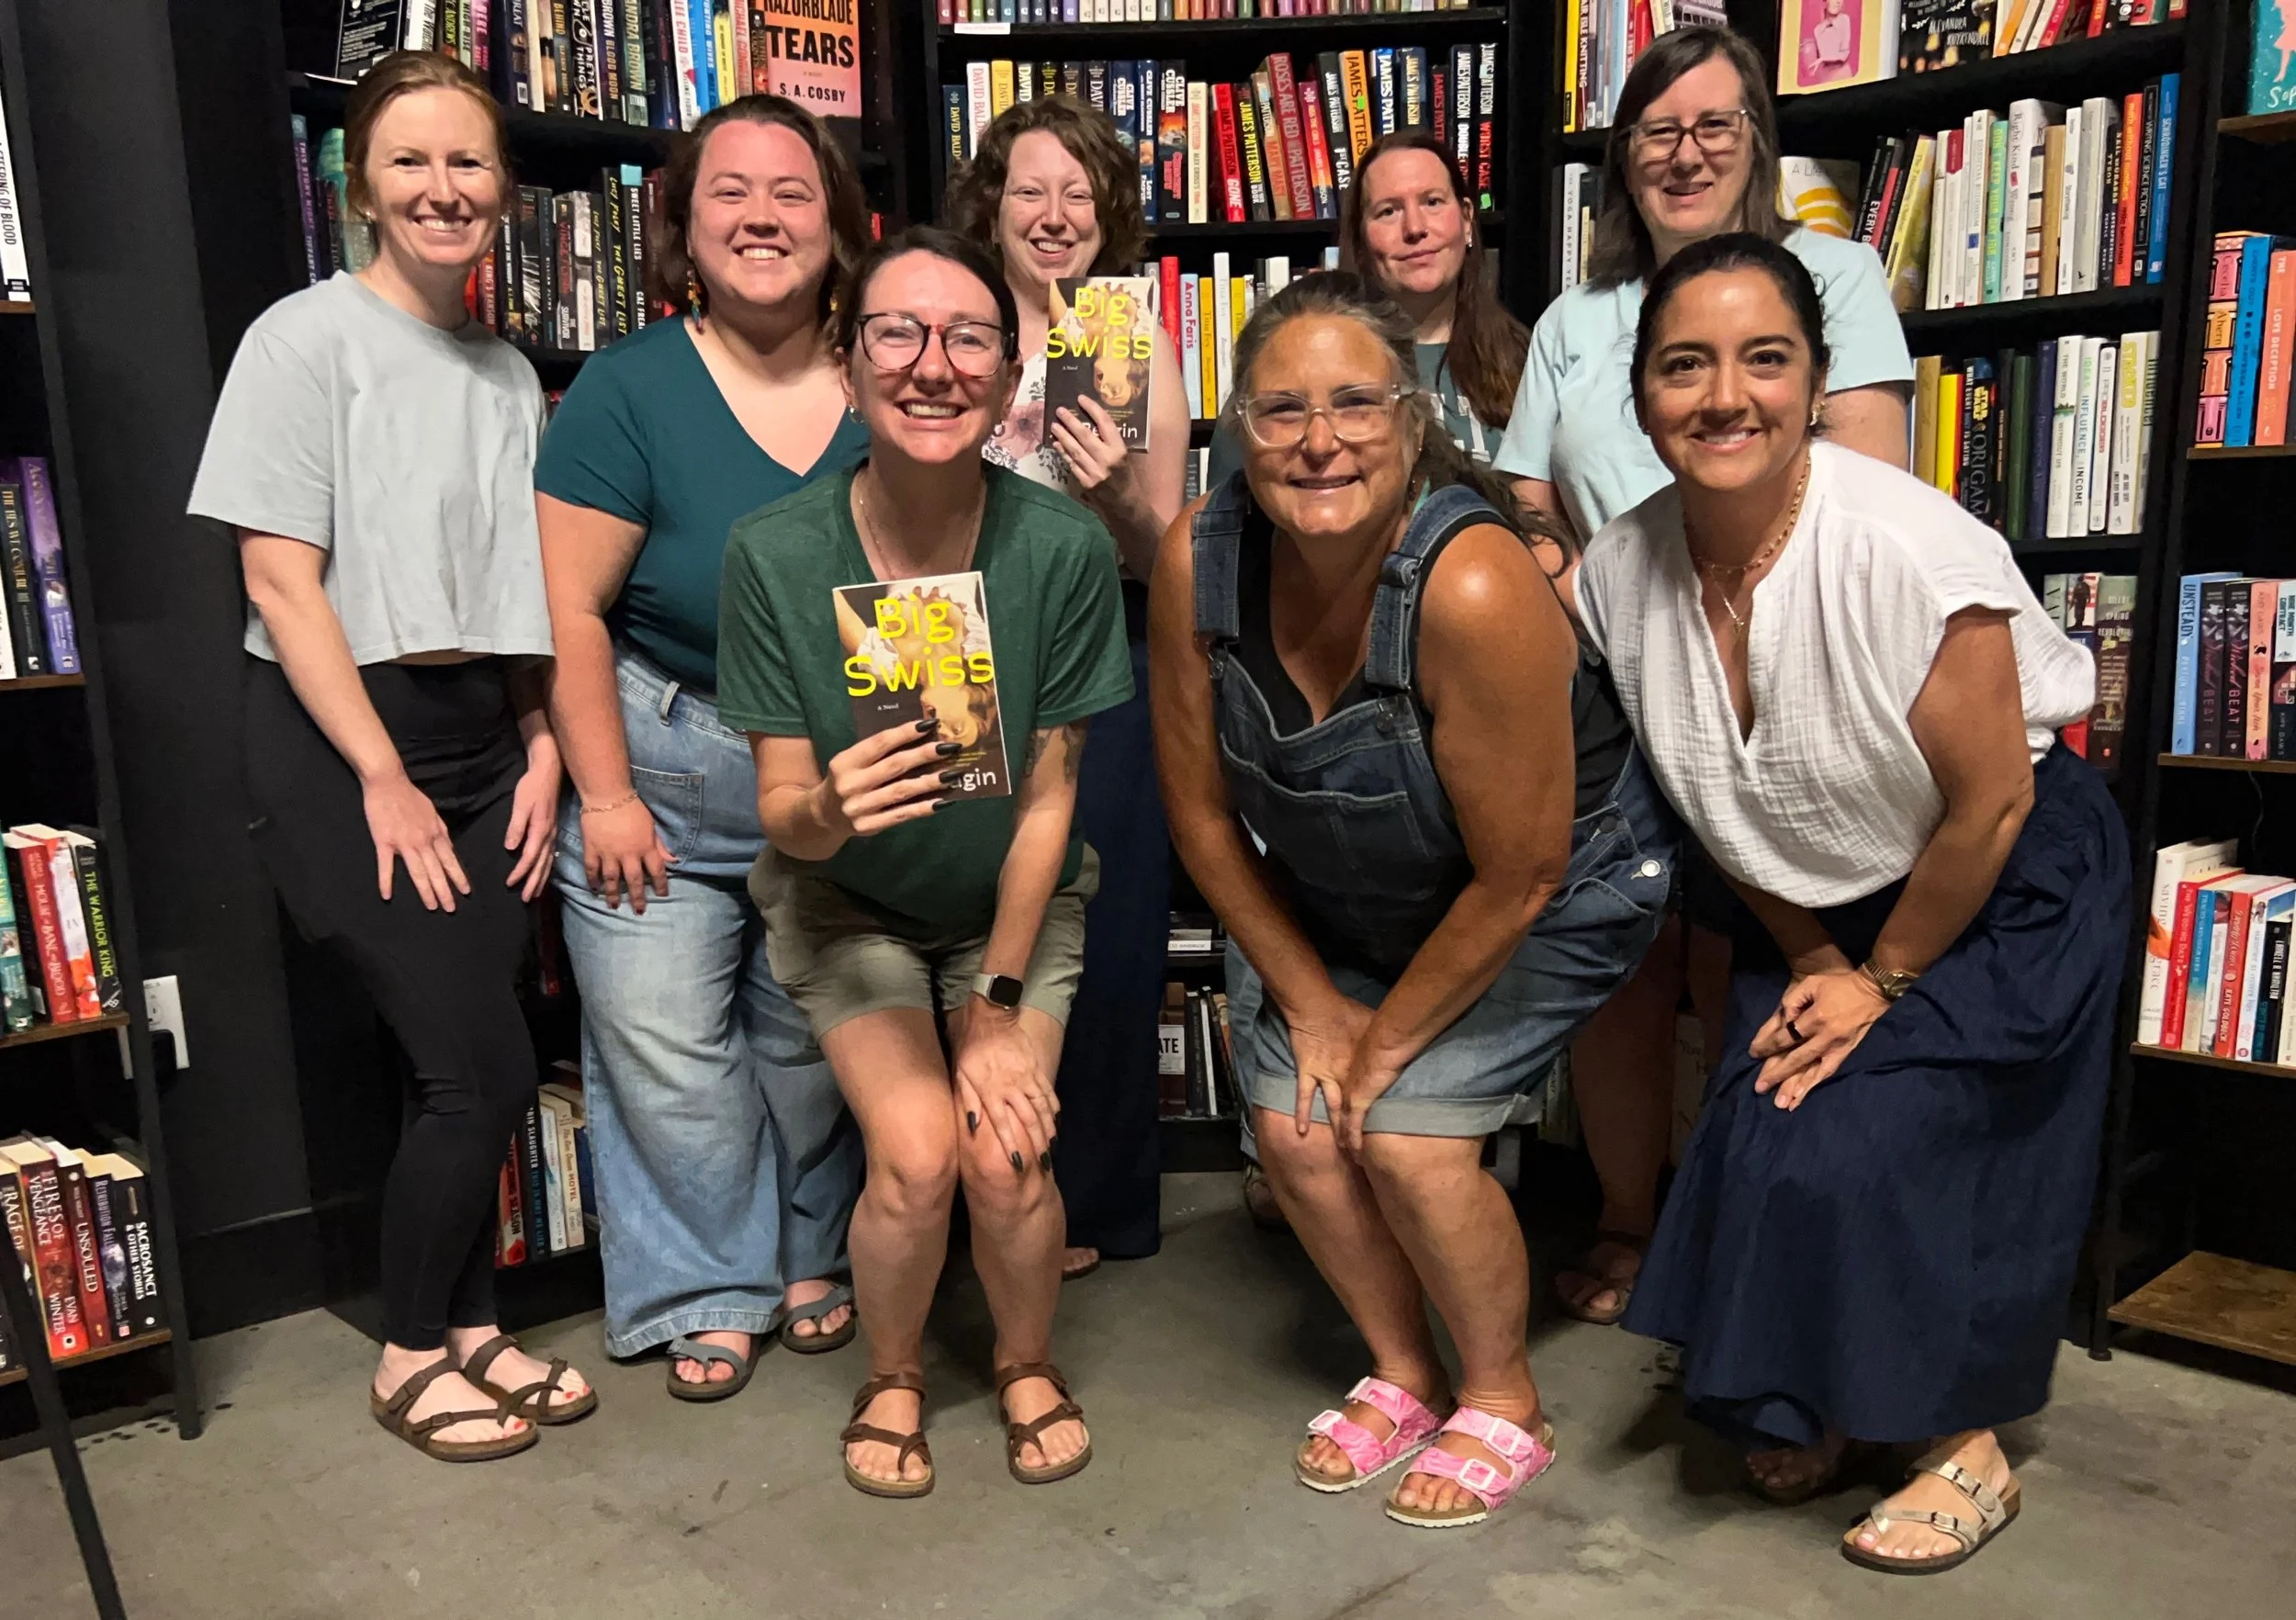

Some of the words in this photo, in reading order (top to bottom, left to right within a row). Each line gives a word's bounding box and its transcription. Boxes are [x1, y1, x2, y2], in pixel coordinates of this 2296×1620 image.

[462, 3, 471, 51] HIGH-RISE
[554, 3, 566, 35] BEHIND
[625, 0, 640, 39] ANDRA
[1580, 17, 1590, 35] ISLE
[1929, 17, 1967, 34] ALEXANDRA
[676, 21, 689, 53] CHILD
[706, 40, 715, 68] WIVES
[765, 25, 855, 69] TEARS
[576, 47, 587, 89] THINGS
[586, 47, 597, 91] PRETTY
[606, 39, 617, 70] BLOOD
[627, 43, 643, 91] BROWN
[1406, 55, 1420, 84] JAMES
[1458, 51, 1471, 77] JAMES
[1579, 37, 1588, 88] KNITTING
[608, 72, 619, 100] MOON
[780, 82, 791, 96] S.
[794, 84, 805, 97] A.
[808, 86, 845, 103] COSBY
[973, 68, 985, 98] DAVID
[1019, 67, 1032, 101] DAVID
[1165, 69, 1176, 113] CUSSLER
[1176, 76, 1186, 107] CLIVE
[1274, 56, 1291, 96] ROSES
[1325, 72, 1339, 96] JAMES
[1345, 56, 1362, 98] JAMES
[1379, 54, 1394, 97] JAMES
[1433, 73, 1445, 107] JAMES
[1089, 80, 1104, 112] DAVI
[1117, 77, 1127, 116] CUSSLER
[1127, 84, 1135, 110] CLIVE
[1279, 96, 1296, 116] ARE
[1406, 84, 1421, 125] PATTERSON
[1457, 77, 1471, 118] PATTERSON
[951, 107, 961, 132] DAVID
[1221, 108, 1232, 132] JAMES
[1240, 102, 1255, 133] JAMES
[1260, 102, 1275, 137] PATTERSON
[1283, 118, 1300, 139] RED
[1329, 96, 1345, 133] PATTERSON
[1351, 97, 1368, 156] ATTERS
[2011, 113, 2022, 144] Right
[2127, 102, 2136, 125] math
[951, 135, 962, 159] BALD
[1457, 124, 1469, 159] DOUBLE
[1480, 121, 1492, 158] WORST
[2114, 131, 2122, 155] NEIL
[2125, 126, 2136, 161] without
[2144, 120, 2154, 154] WRITING
[1224, 133, 1236, 176] PATTERSON
[1244, 133, 1262, 185] PATTERSON
[2010, 145, 2020, 169] Kind
[2141, 154, 2151, 186] SCIENCE
[610, 177, 618, 199] LUCY
[1289, 145, 1312, 213] PATTERSON
[1478, 162, 1491, 190] CASE
[2121, 163, 2133, 201] numbers
[2157, 176, 2167, 190] CAT
[0, 195, 11, 209] OF
[299, 141, 309, 163] THIS
[305, 235, 317, 271] TIFFANY
[630, 187, 639, 212] SWEET
[1227, 178, 1243, 209] GONE
[1250, 185, 1258, 204] BOOK
[1566, 190, 1574, 220] YOGA
[2139, 187, 2148, 218] FICTION
[1, 212, 17, 245] BLOOD
[610, 202, 621, 233] FOLEY
[632, 214, 641, 242] LITTLE
[1865, 200, 1881, 235] EVERY
[558, 222, 568, 253] VINCE
[613, 244, 622, 264] THE
[634, 243, 643, 261] LIES
[1565, 226, 1573, 264] HAPPY
[2116, 226, 2128, 265] beckman
[485, 265, 495, 291] KING'S
[560, 257, 570, 295] FLYNN
[2219, 255, 2233, 298] Cecelia
[2276, 256, 2288, 275] THE
[596, 275, 606, 307] GUEST
[613, 264, 626, 308] GUEST
[636, 291, 645, 306] CAZ
[1184, 282, 1196, 317] Anna
[485, 293, 497, 325] RANSOM
[561, 306, 570, 340] SURVIVOR
[616, 309, 627, 336] LIST
[1074, 287, 1131, 326] Big
[1203, 312, 1212, 332] Tina
[2271, 308, 2283, 336] LOVE
[1045, 326, 1154, 360] Swiss
[1185, 319, 1197, 349] Faris
[2214, 309, 2228, 346] Ahern
[1966, 366, 1975, 387] WHAT
[2062, 354, 2070, 369] THE
[2267, 337, 2281, 390] DECEPTION
[1964, 388, 1974, 411] EVERY
[2059, 370, 2068, 399] WORLD
[1972, 387, 1982, 421] WARS
[1980, 386, 1989, 420] STAR
[2099, 378, 2110, 454] PROBLOGGER
[1084, 422, 1139, 439] Bein
[2055, 421, 2065, 457] WITHOUT
[1969, 433, 1987, 518] ORIGAM
[2054, 458, 2062, 469] US
[2, 490, 15, 507] THE
[2074, 466, 2085, 507] INCOME
[8, 532, 21, 547] WE
[11, 548, 28, 589] CONJURE
[873, 593, 955, 643] Big
[2180, 584, 2197, 638] UNSTEADY
[2278, 597, 2288, 631] CONTRACT
[2286, 612, 2296, 637] MONTH
[843, 647, 995, 697] Swiss
[2228, 642, 2247, 690] Wicked
[2202, 691, 2215, 725] BEAT
[2227, 691, 2241, 725] BEAT
[2277, 731, 2286, 756] DAWS
[84, 872, 98, 892] THE
[88, 895, 108, 948] WARRIOR
[2157, 882, 2171, 927] saving
[2180, 904, 2194, 943] WEDDING
[98, 950, 114, 978] KING
[2177, 944, 2187, 964] DATE
[2149, 956, 2163, 990] grace
[2222, 987, 2234, 1007] KATE
[2219, 1007, 2232, 1043] GOLDBECK
[526, 1127, 539, 1168] SLAUGHTER
[41, 1176, 64, 1222] FIRES
[94, 1179, 111, 1228] RETRIBUTION
[567, 1173, 577, 1201] MOTEL
[4, 1192, 24, 1231] RAGE
[29, 1176, 52, 1246] VENGEANCE
[510, 1196, 521, 1235] SEASON
[51, 1223, 65, 1240] OF
[127, 1232, 139, 1263] OTHER
[75, 1222, 99, 1293] UNSOULED
[136, 1221, 158, 1298] SACROSANCT
[131, 1264, 145, 1300] STORIES
[49, 1292, 66, 1333] WINTER
[63, 1296, 81, 1323] EVAN
